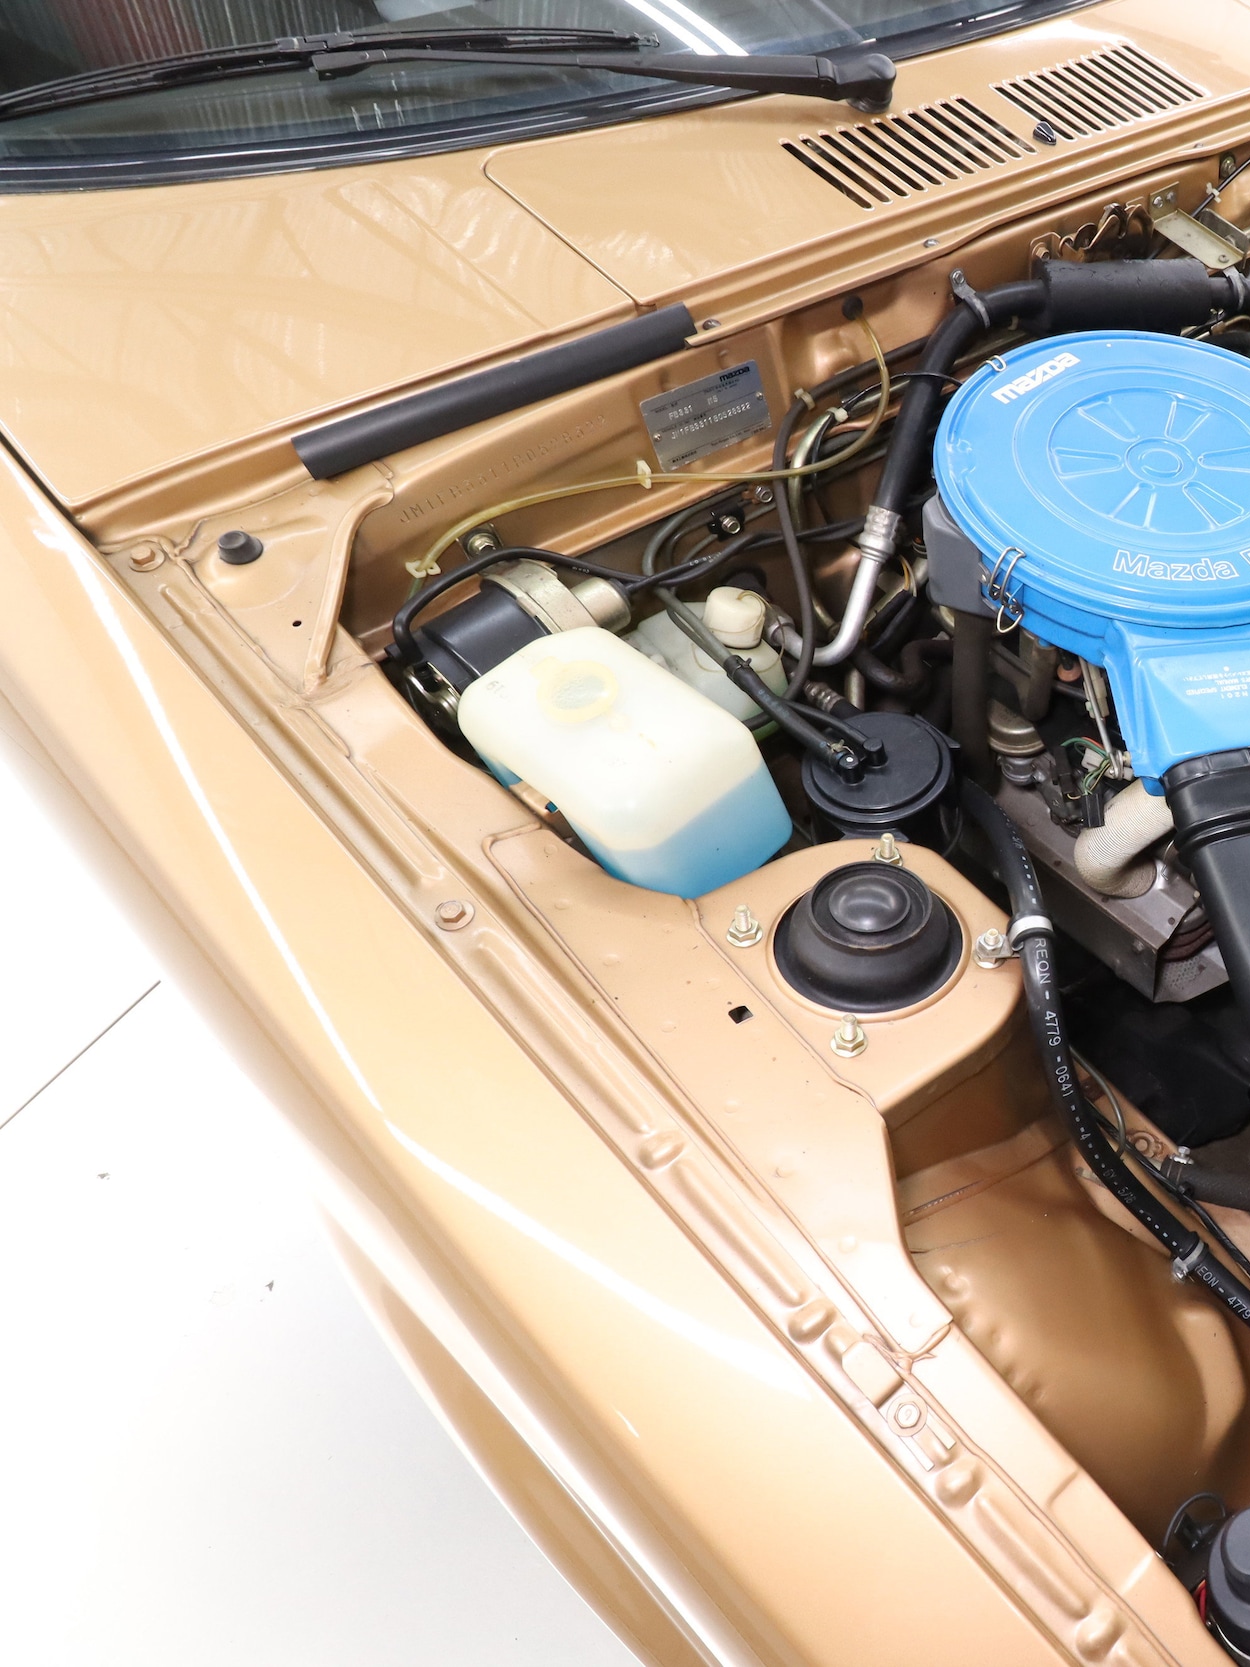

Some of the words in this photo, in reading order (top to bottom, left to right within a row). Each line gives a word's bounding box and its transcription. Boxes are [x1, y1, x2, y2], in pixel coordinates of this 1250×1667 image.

[720, 366, 750, 382] mazda
[990, 352, 1081, 404] mazda
[1113, 550, 1239, 581] Mazda
[1031, 936, 1053, 984] REON
[1042, 1009, 1062, 1046] 4779
[1053, 1064, 1074, 1098] 0641
